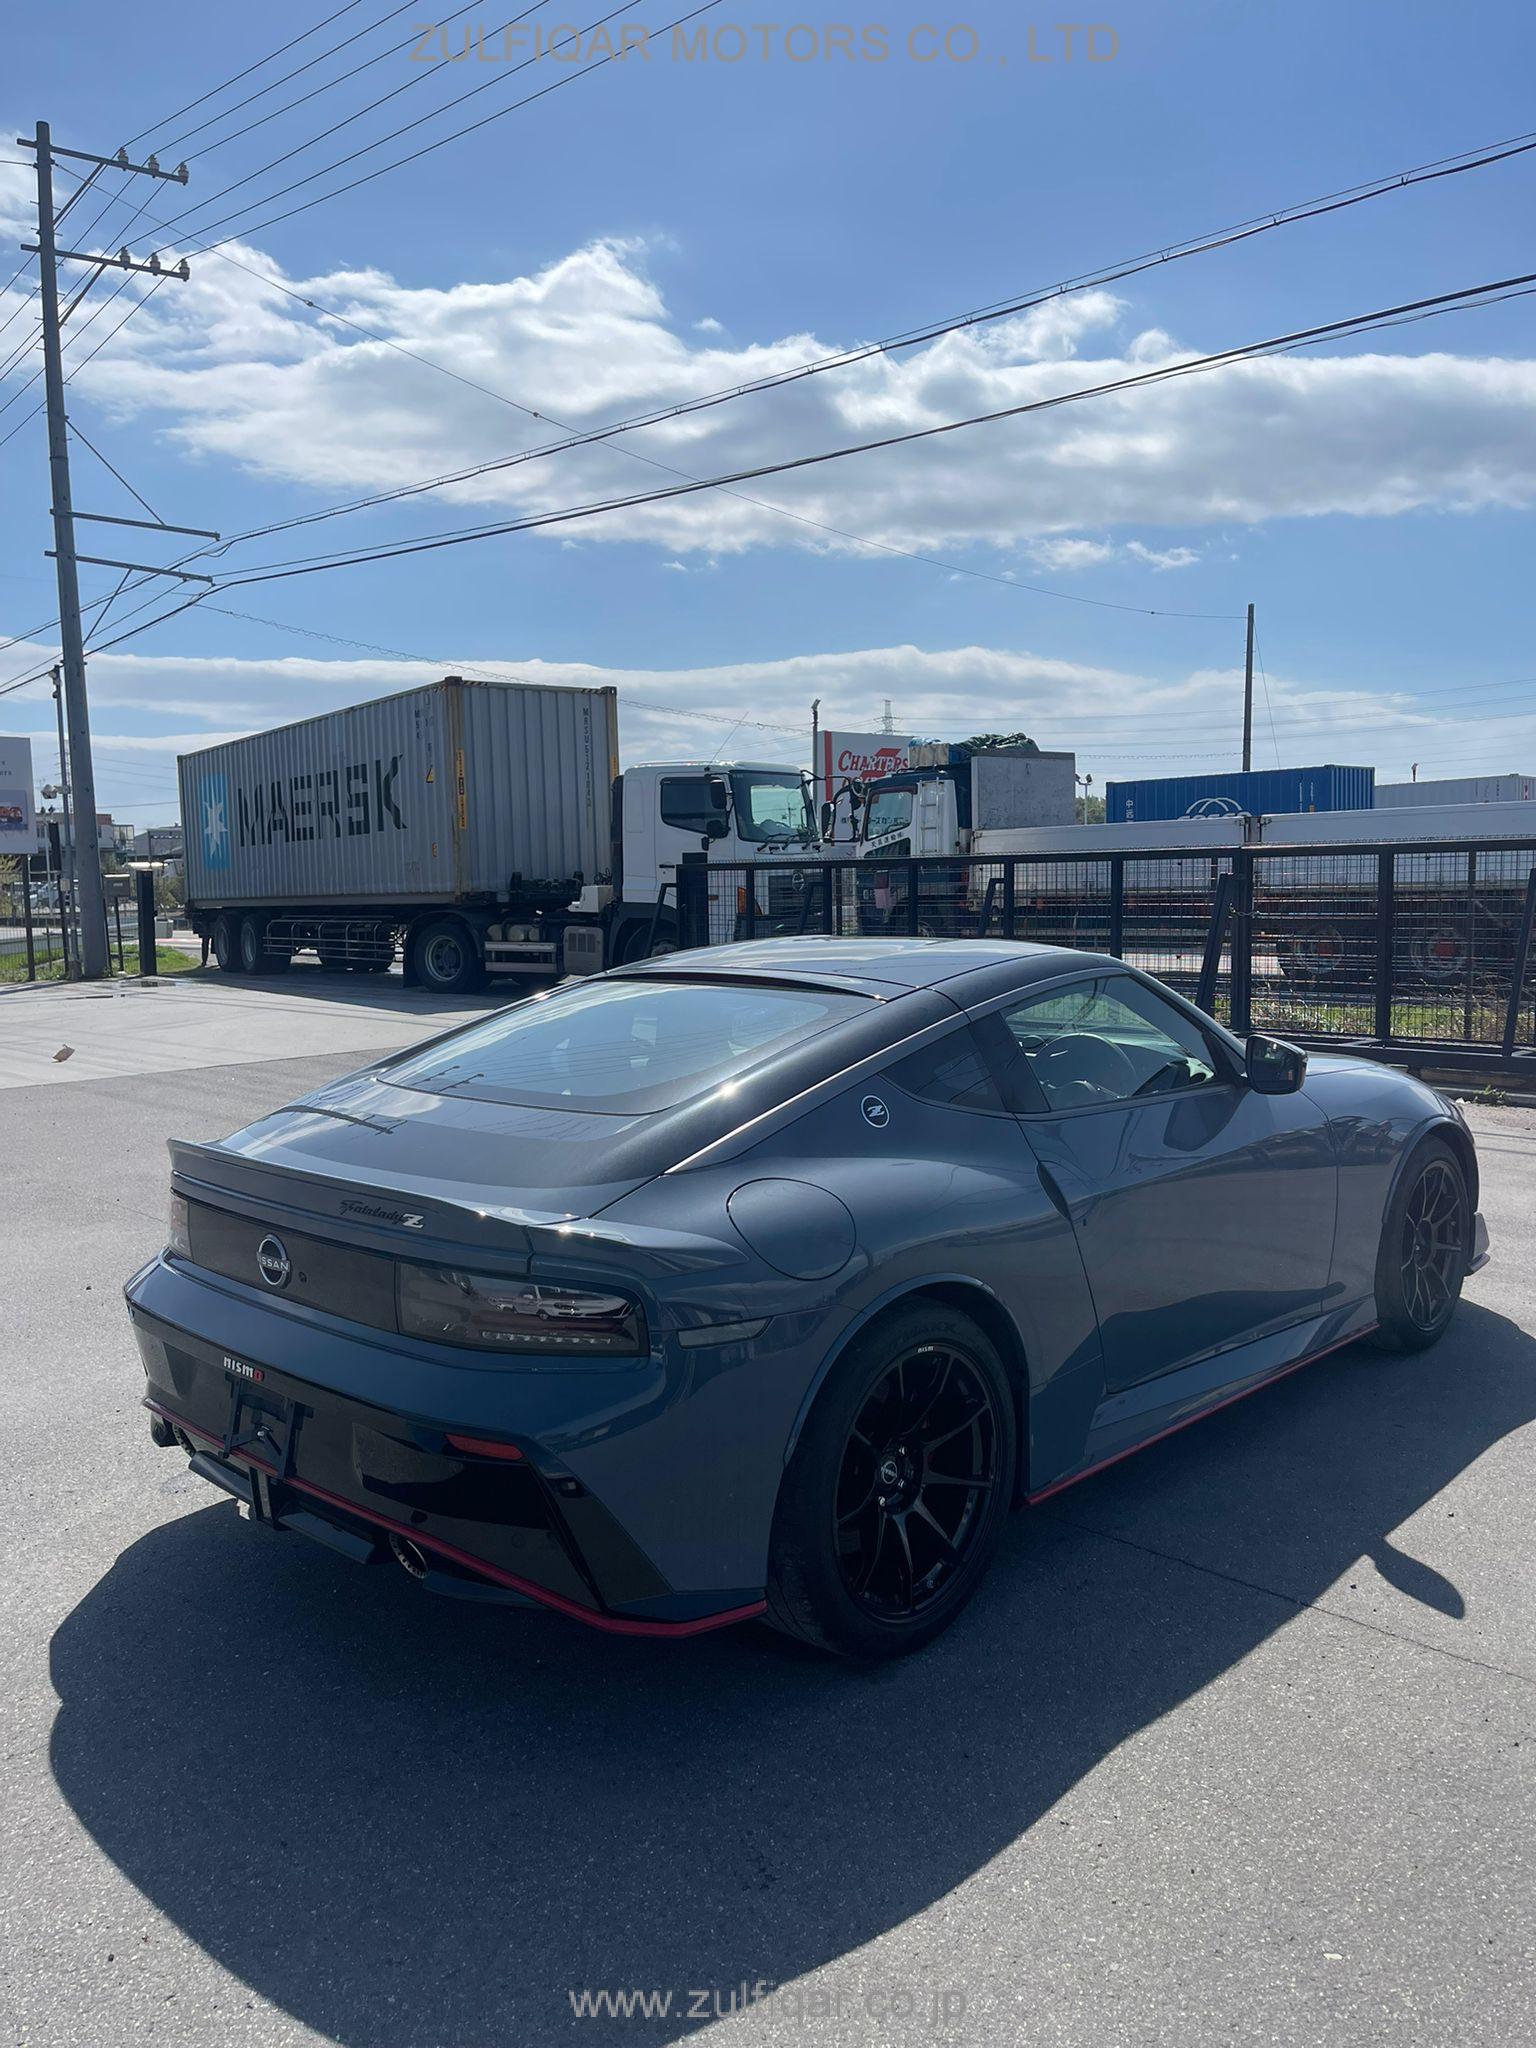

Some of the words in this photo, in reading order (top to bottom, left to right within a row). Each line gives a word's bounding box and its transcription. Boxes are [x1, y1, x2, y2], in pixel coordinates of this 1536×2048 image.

[838, 750, 909, 773] CHARTERS
[237, 754, 408, 848] MAERSK
[340, 1200, 404, 1225] Fairlady
[402, 1212, 424, 1229] Z
